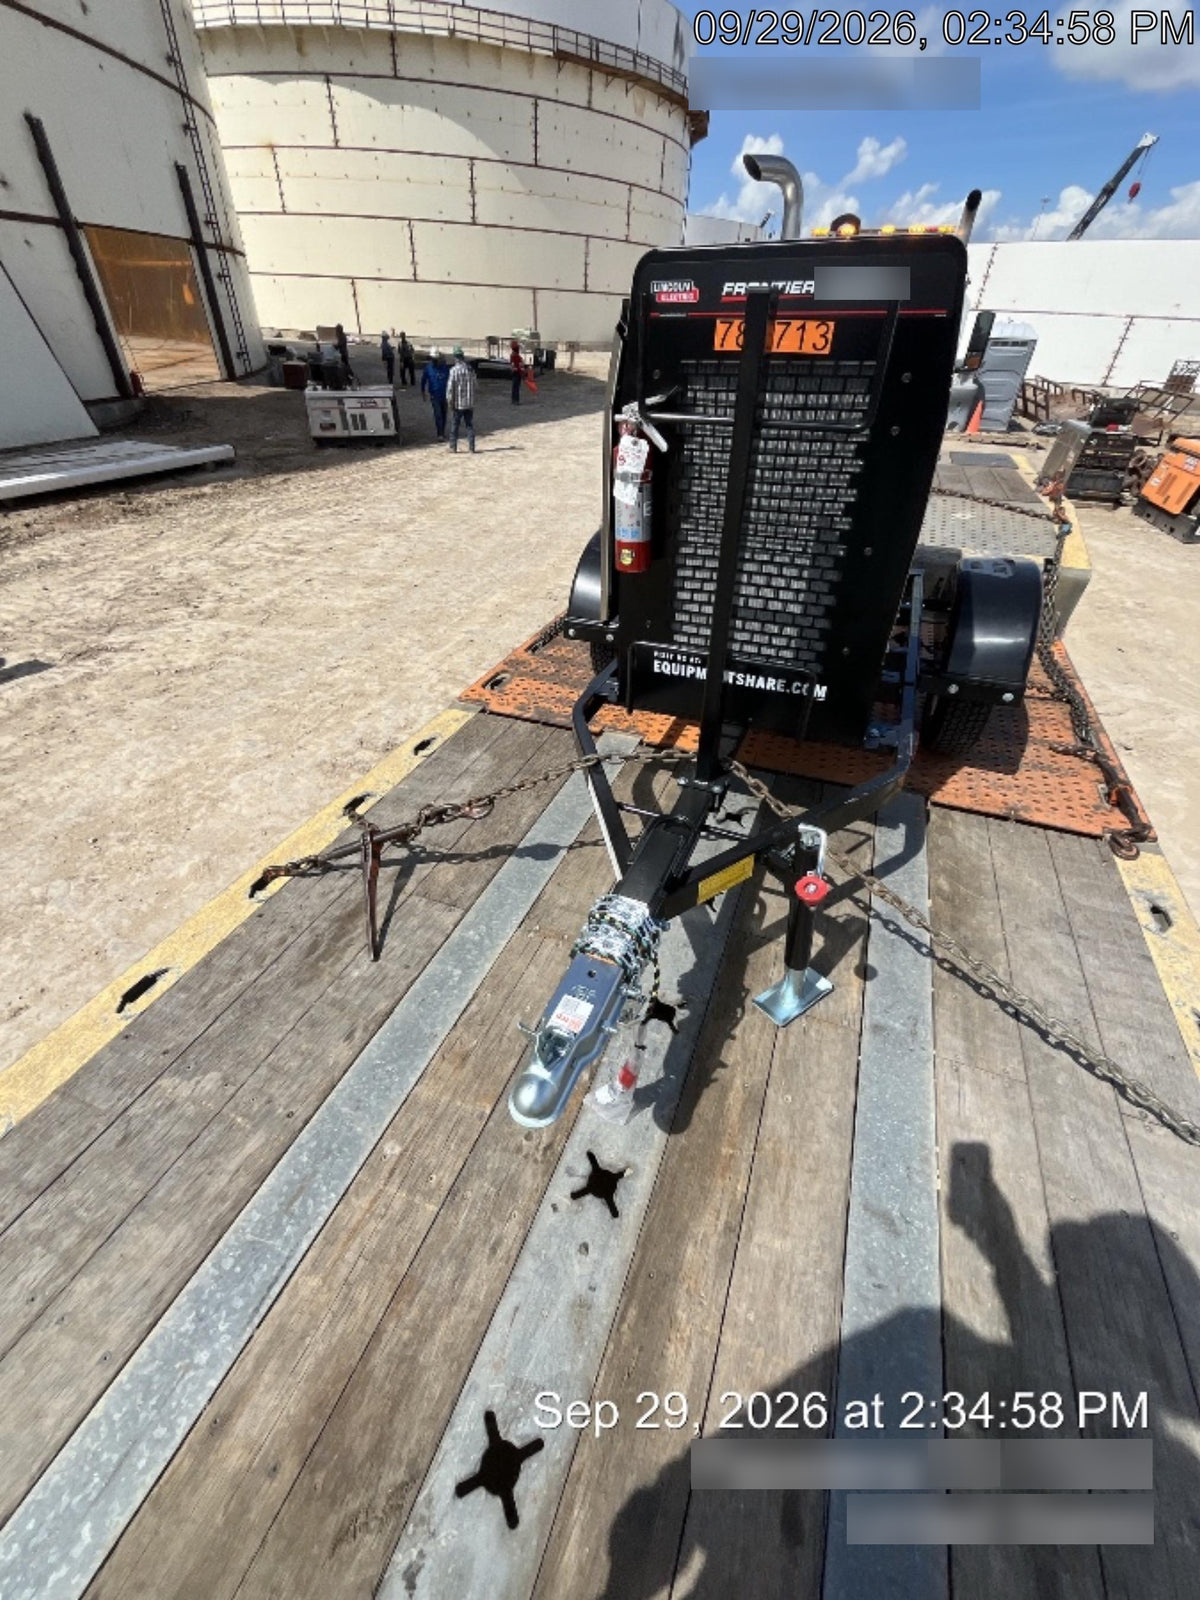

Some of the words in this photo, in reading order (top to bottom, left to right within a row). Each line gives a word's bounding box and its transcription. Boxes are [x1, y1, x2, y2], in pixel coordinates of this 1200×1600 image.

[653, 281, 691, 292] LINCOLN
[719, 320, 830, 351] 78713
[653, 659, 828, 698] EQUIPMTSHARE.COM
